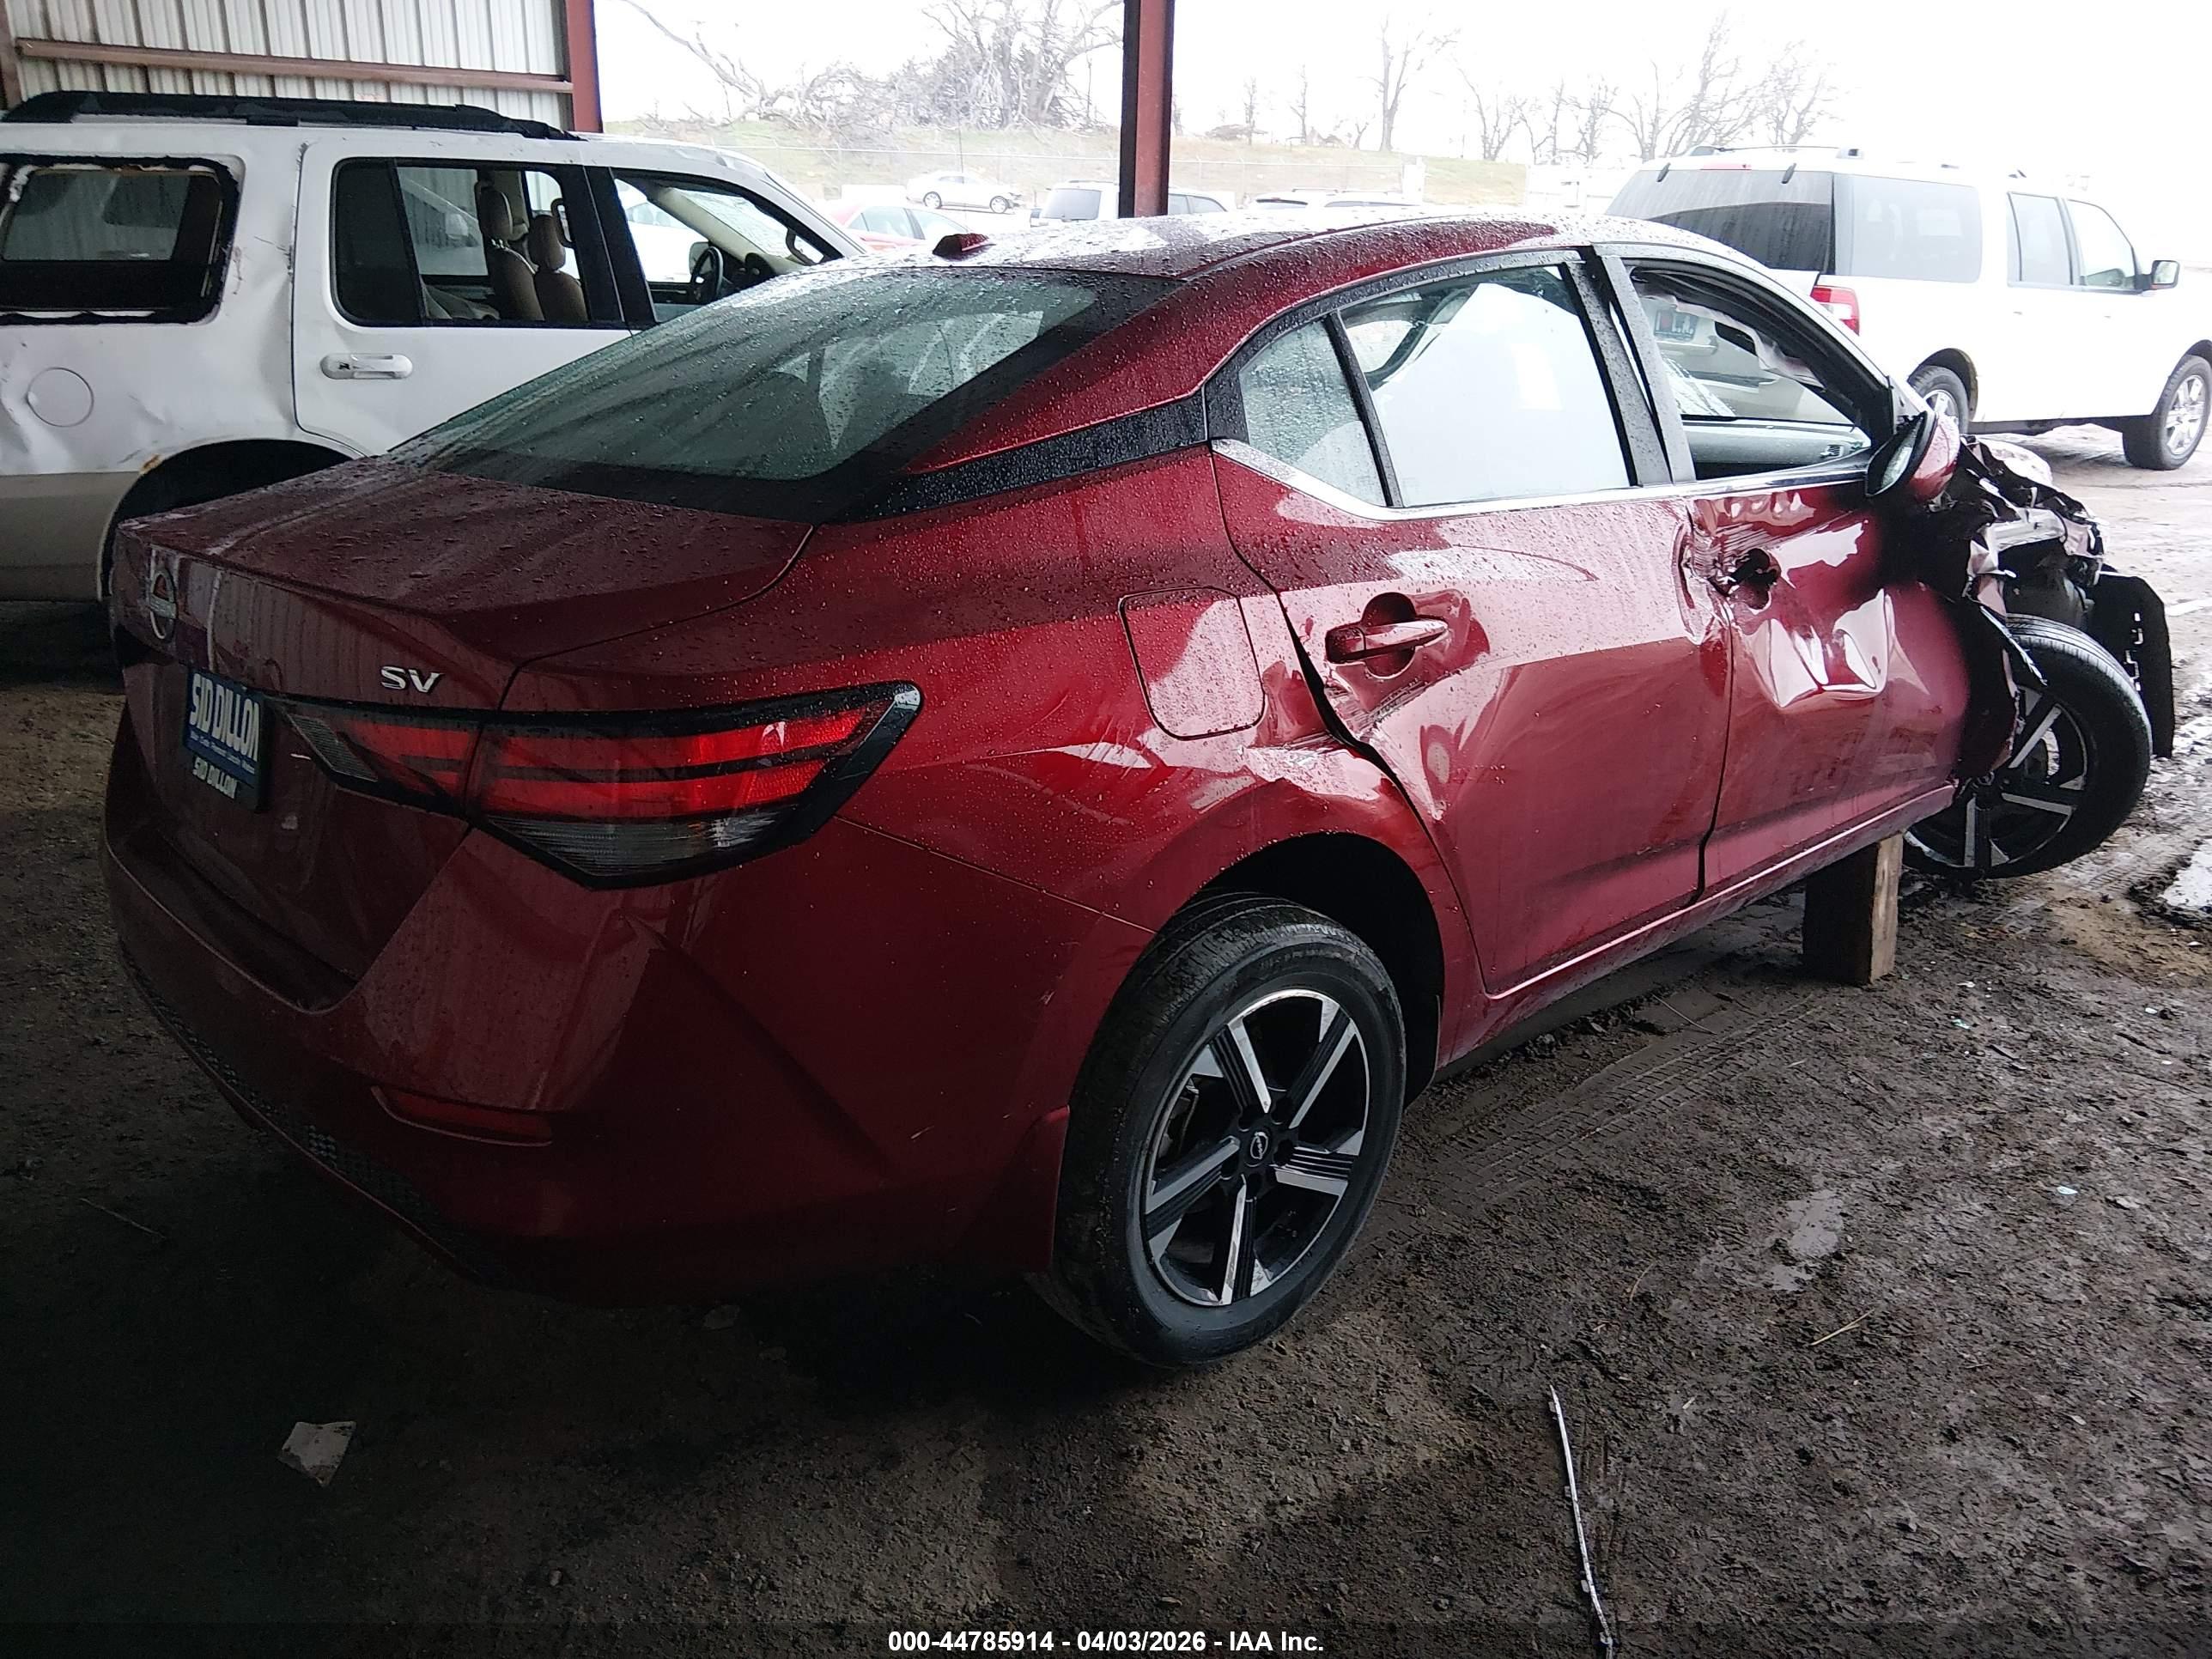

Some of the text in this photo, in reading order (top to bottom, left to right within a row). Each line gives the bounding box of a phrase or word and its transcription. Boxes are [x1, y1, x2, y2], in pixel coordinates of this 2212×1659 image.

[380, 665, 445, 693] SV
[189, 672, 214, 733] SID
[211, 684, 260, 763] DILLON
